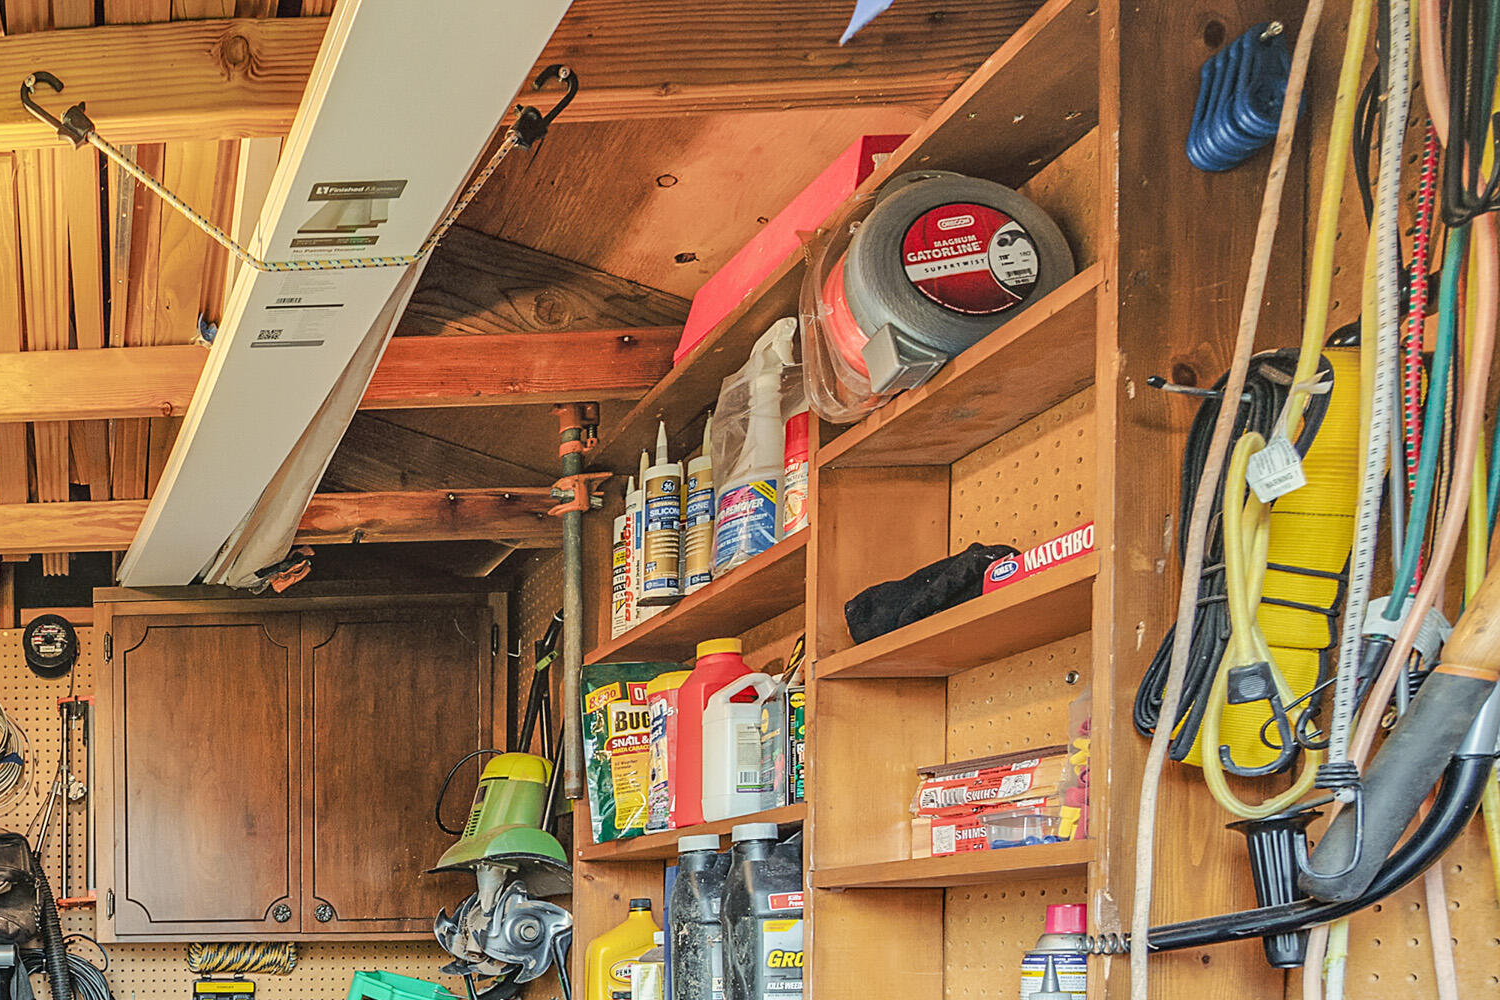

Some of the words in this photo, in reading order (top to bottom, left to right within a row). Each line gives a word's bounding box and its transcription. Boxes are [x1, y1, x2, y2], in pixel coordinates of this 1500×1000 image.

[329, 186, 364, 194] Finished
[941, 217, 971, 228] OREGON
[933, 234, 977, 248] MAGNUM
[906, 242, 982, 263] GATORLINE
[924, 257, 985, 274] SUPERTWIST
[1265, 472, 1293, 489] WARNING
[649, 506, 680, 517] SILICON
[687, 501, 709, 513] CONE
[1023, 524, 1094, 573] MATCHBO
[615, 710, 650, 733] BUG
[612, 736, 640, 749] SNAIL
[641, 736, 649, 745] &
[966, 787, 999, 802] SHIMS
[955, 826, 987, 841] SHIMS
[766, 950, 803, 968] GRO
[615, 969, 631, 977] PENN
[766, 982, 785, 990] KILLS
[785, 981, 803, 990] WEED
